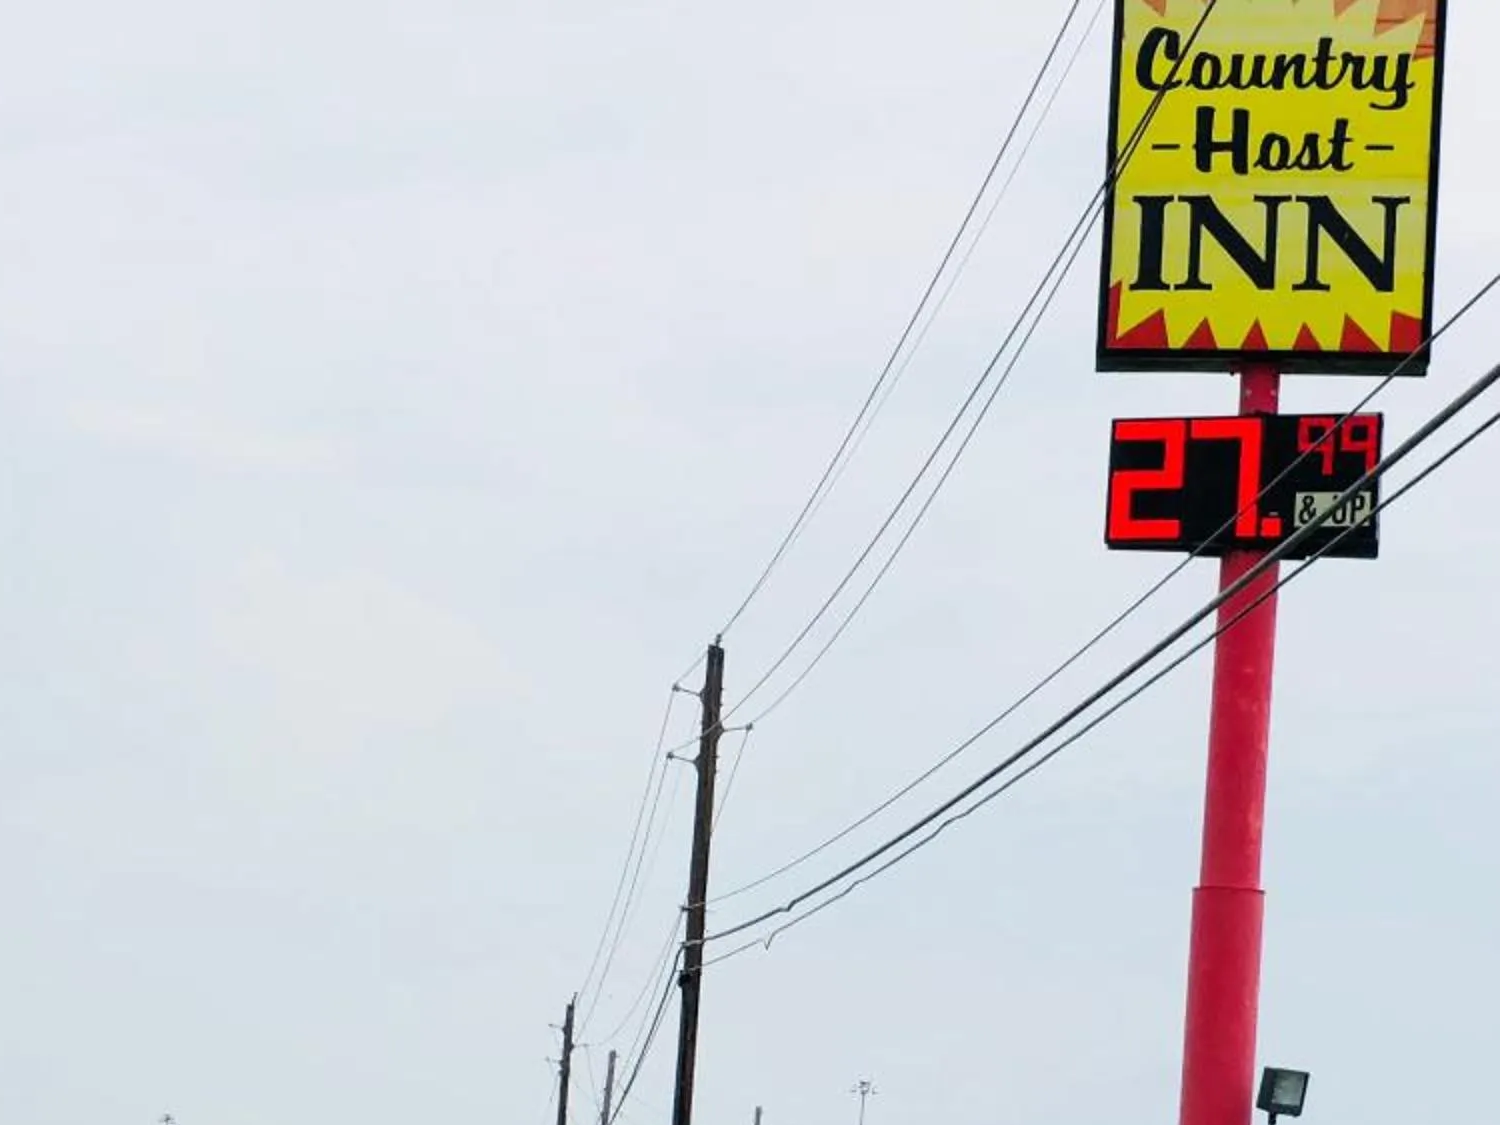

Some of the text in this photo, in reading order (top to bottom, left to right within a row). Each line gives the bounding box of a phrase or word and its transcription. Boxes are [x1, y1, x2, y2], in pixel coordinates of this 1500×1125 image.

[1135, 26, 1415, 110] Country
[1129, 194, 1411, 292] INN
[1299, 494, 1366, 525] & UP
